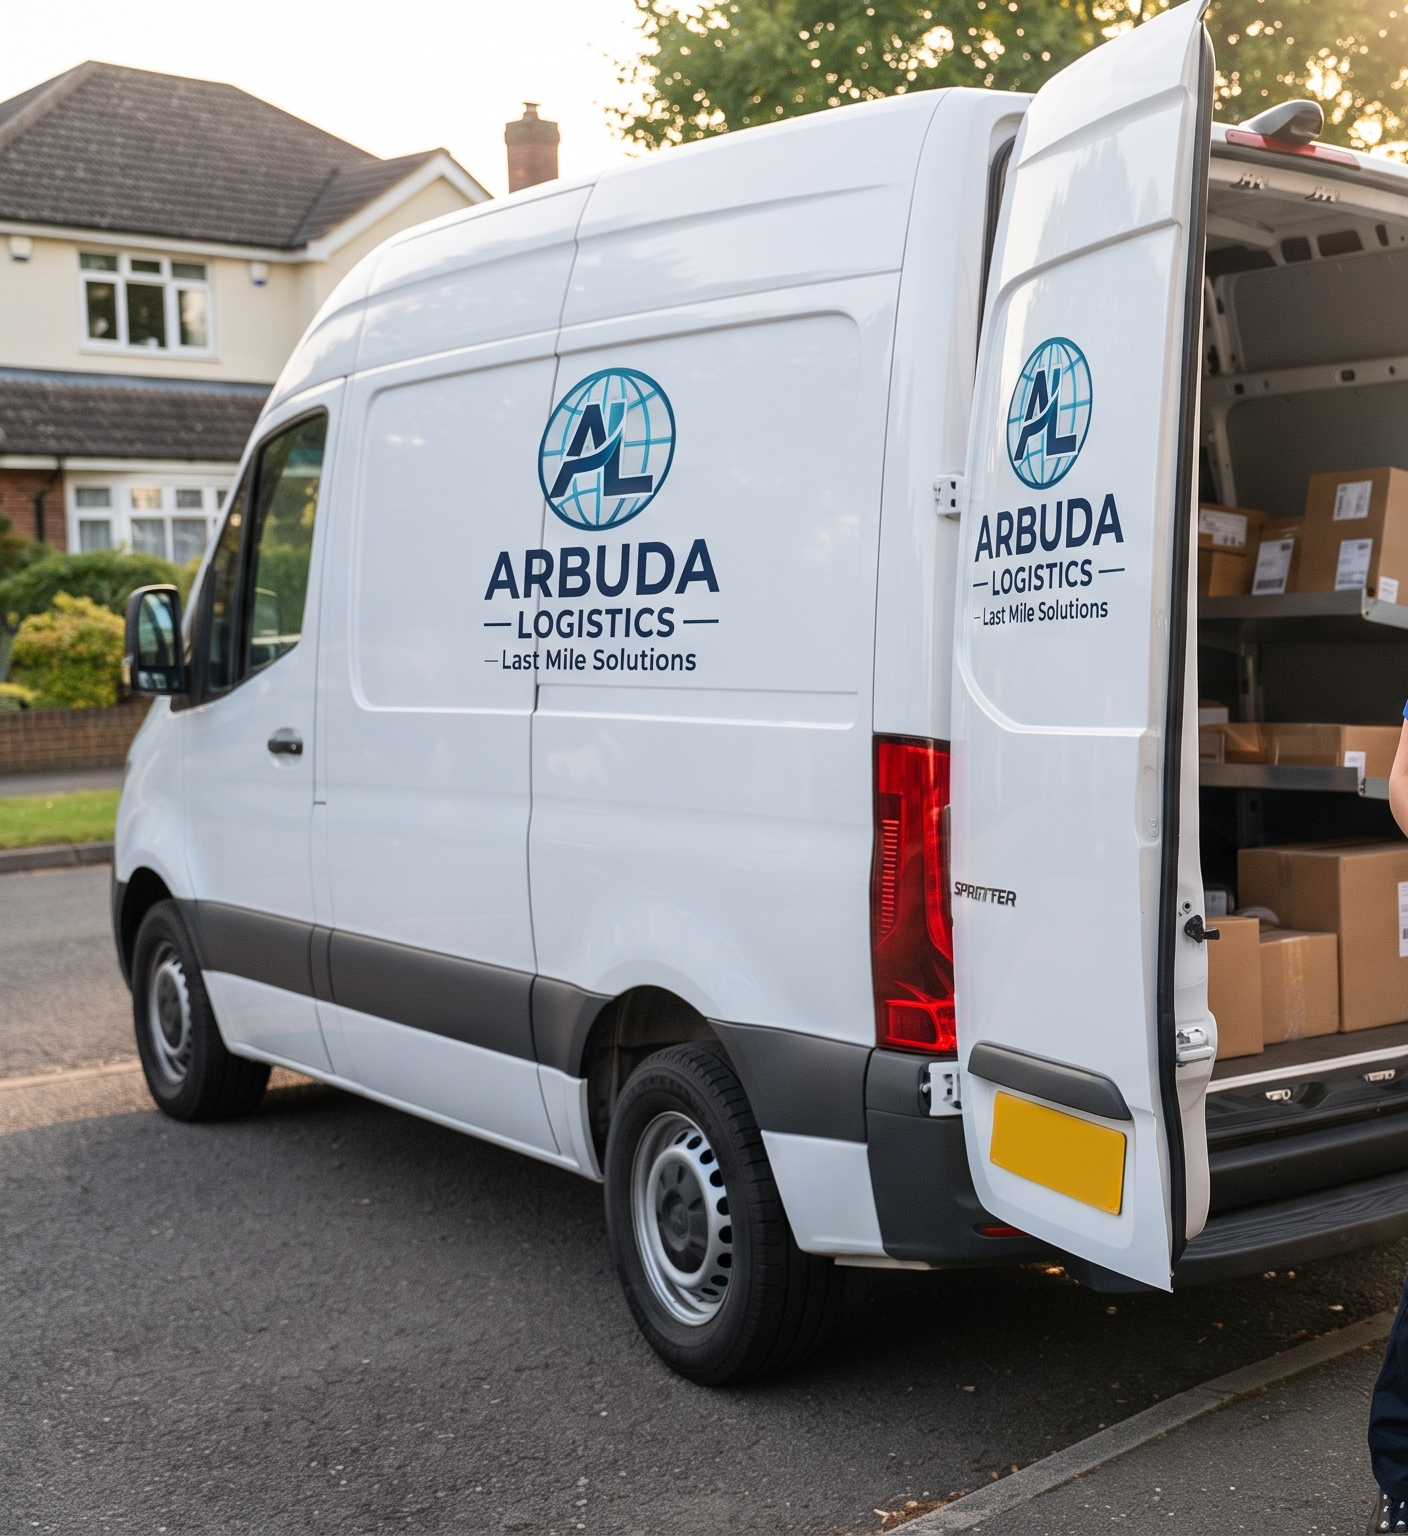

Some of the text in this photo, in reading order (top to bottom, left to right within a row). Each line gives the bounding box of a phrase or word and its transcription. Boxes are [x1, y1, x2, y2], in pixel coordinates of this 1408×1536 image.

[974, 493, 1124, 562] ARBUDA
[484, 538, 720, 600] ARBUDA
[992, 559, 1093, 596] LOGISTICS
[518, 606, 675, 639] LOGISTICS
[983, 598, 1108, 626] Last Mile Solutions
[502, 647, 697, 671] Last Mile Solutions
